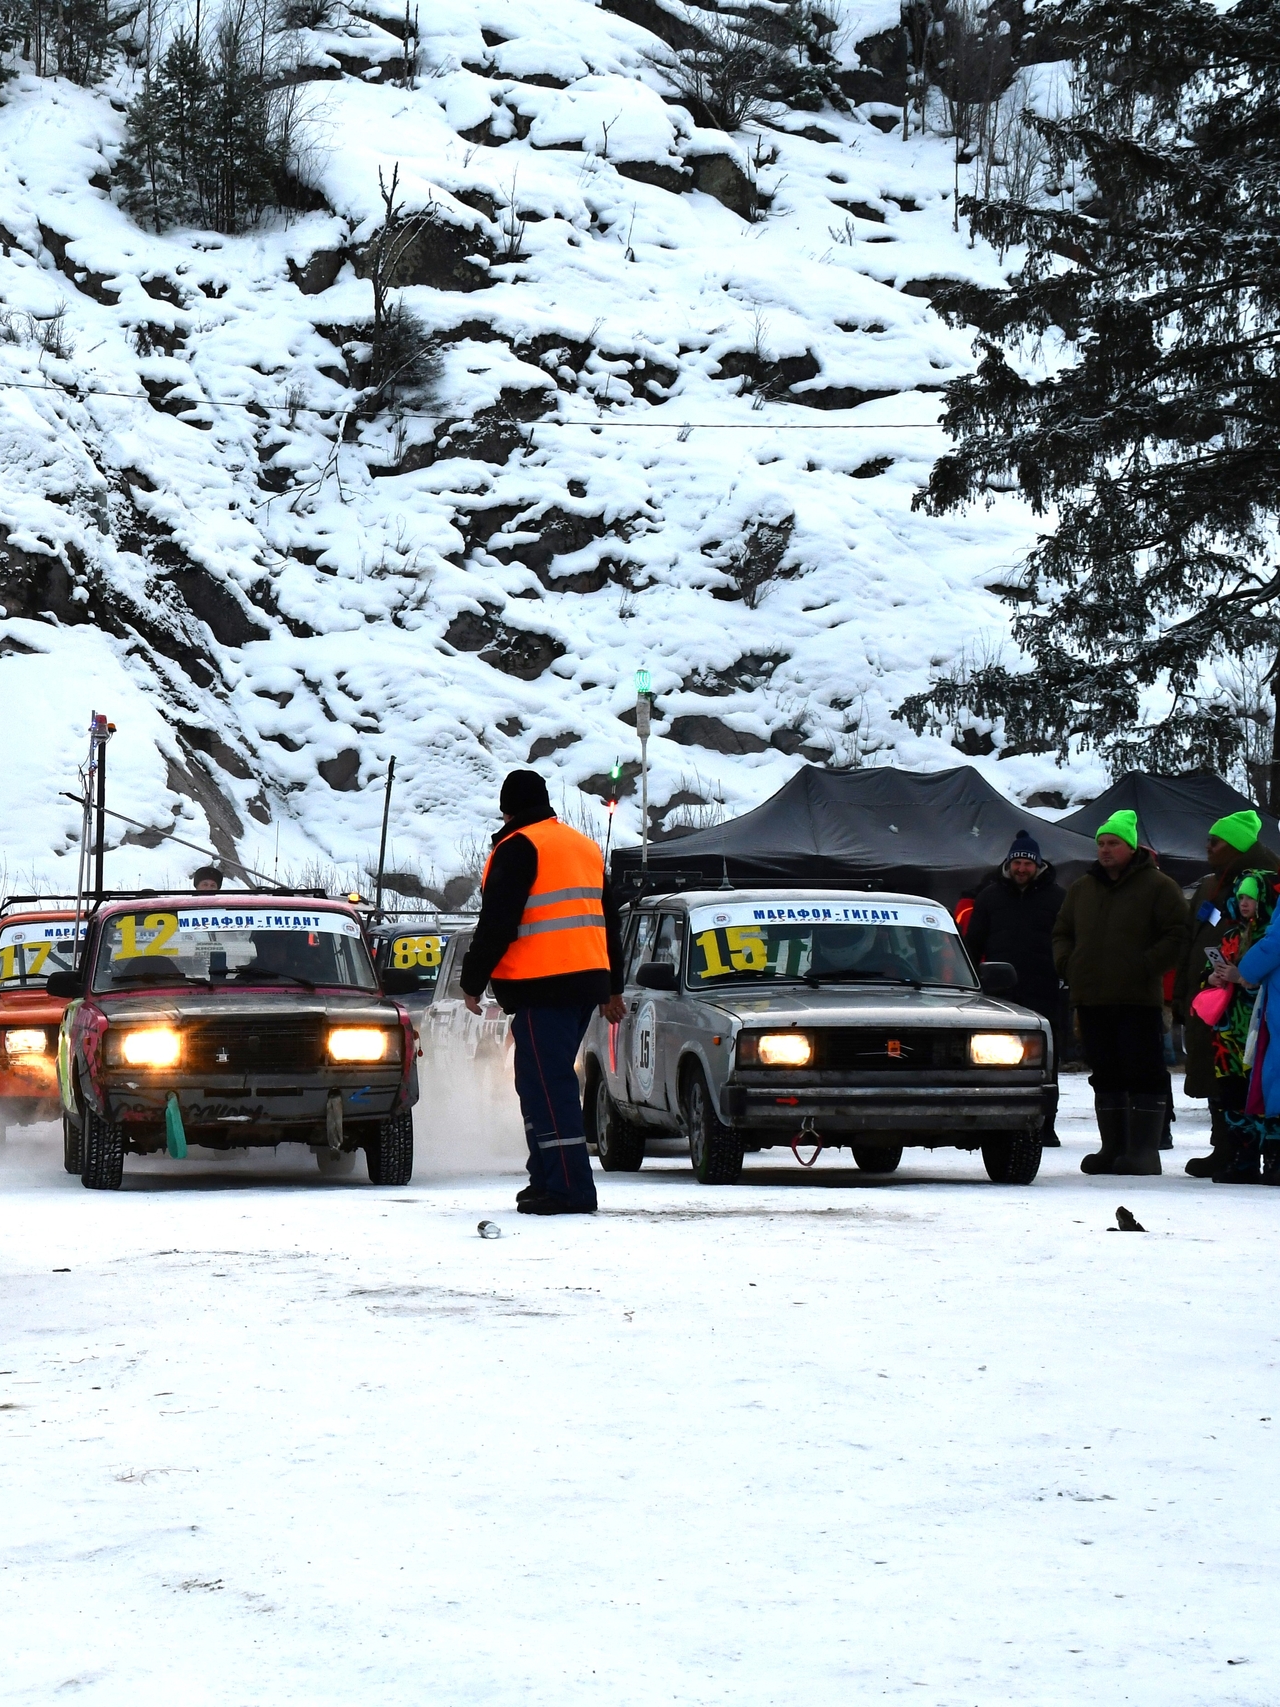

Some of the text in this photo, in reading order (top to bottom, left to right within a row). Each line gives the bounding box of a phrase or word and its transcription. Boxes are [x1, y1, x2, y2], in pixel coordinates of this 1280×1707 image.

[1009, 851, 1037, 861] SOCHI
[115, 913, 179, 961] 12
[393, 936, 442, 970] 88
[695, 926, 768, 978] 15
[639, 1029, 651, 1069] 15
